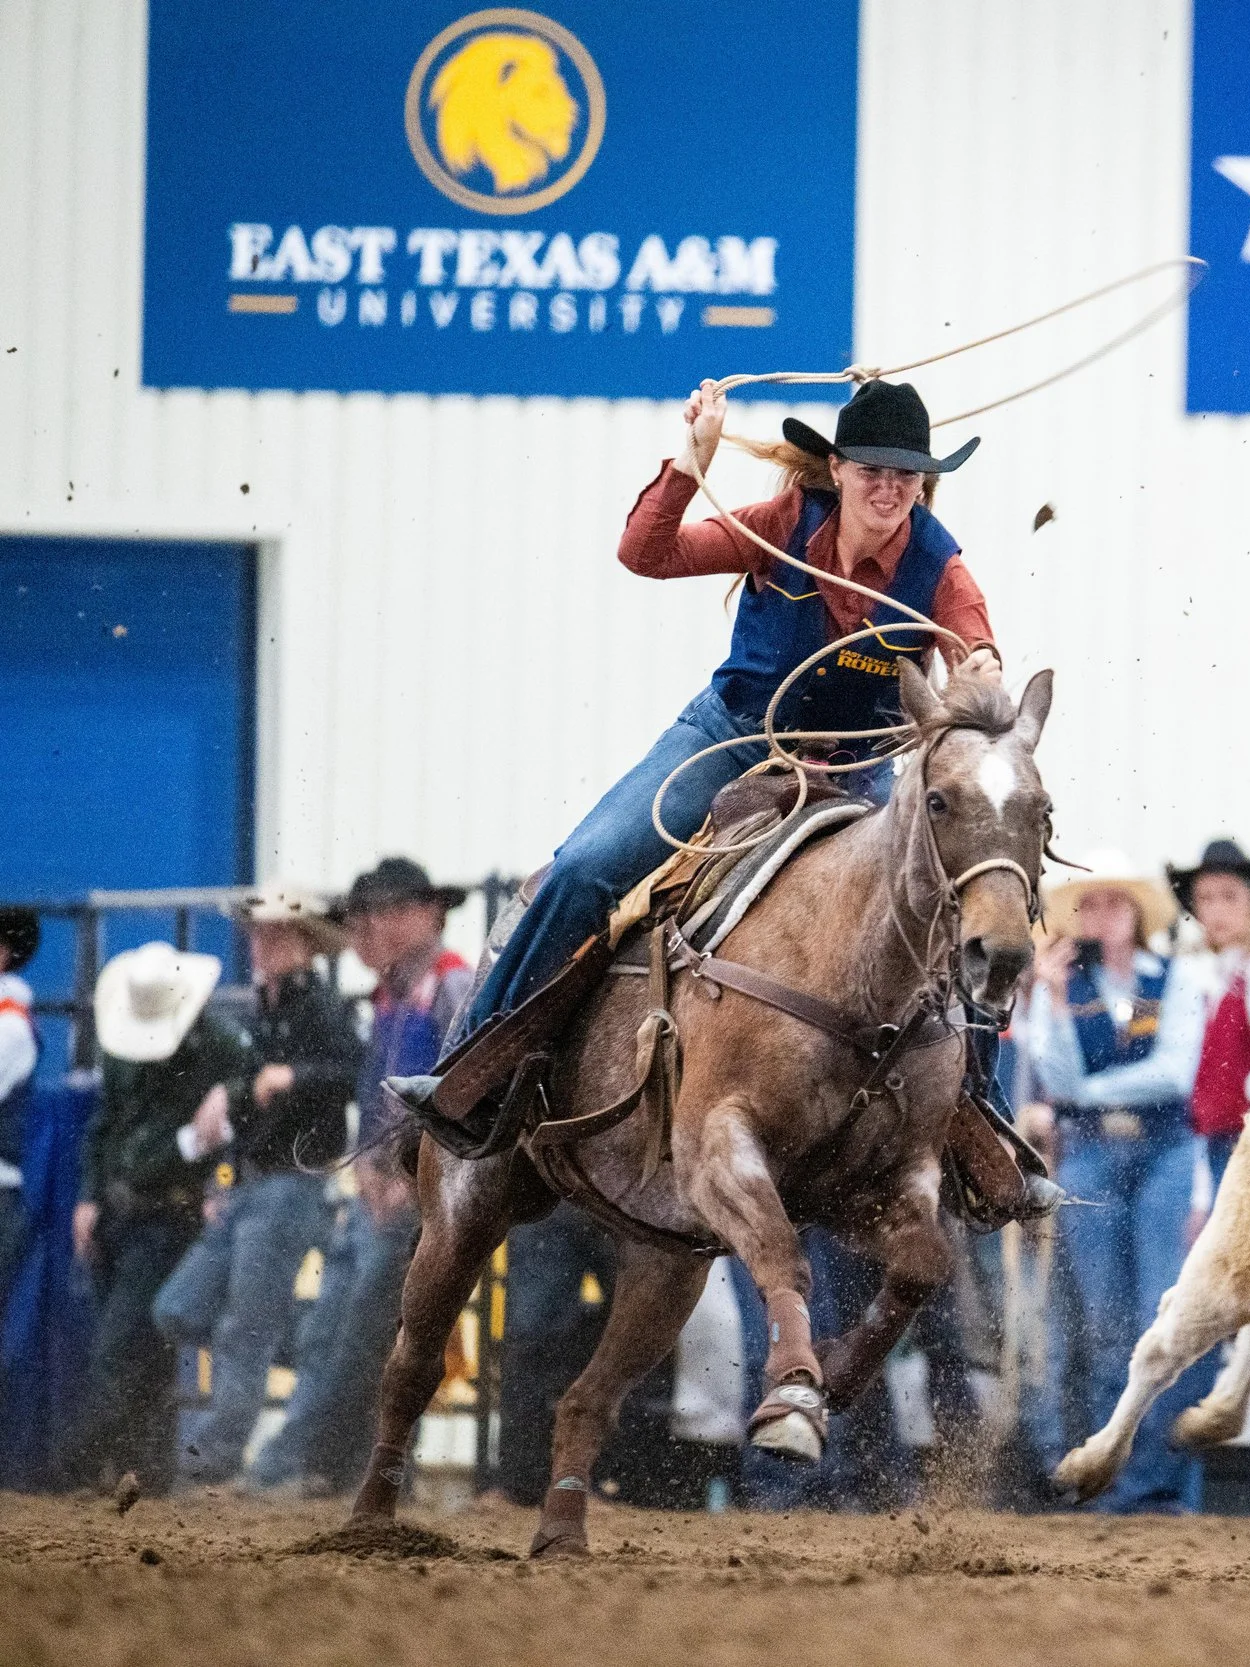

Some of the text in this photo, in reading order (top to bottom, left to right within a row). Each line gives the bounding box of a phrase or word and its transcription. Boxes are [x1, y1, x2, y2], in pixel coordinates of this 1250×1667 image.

[229, 222, 779, 296] EAST TEXAS A&M
[316, 290, 686, 333] UNIVERSITY
